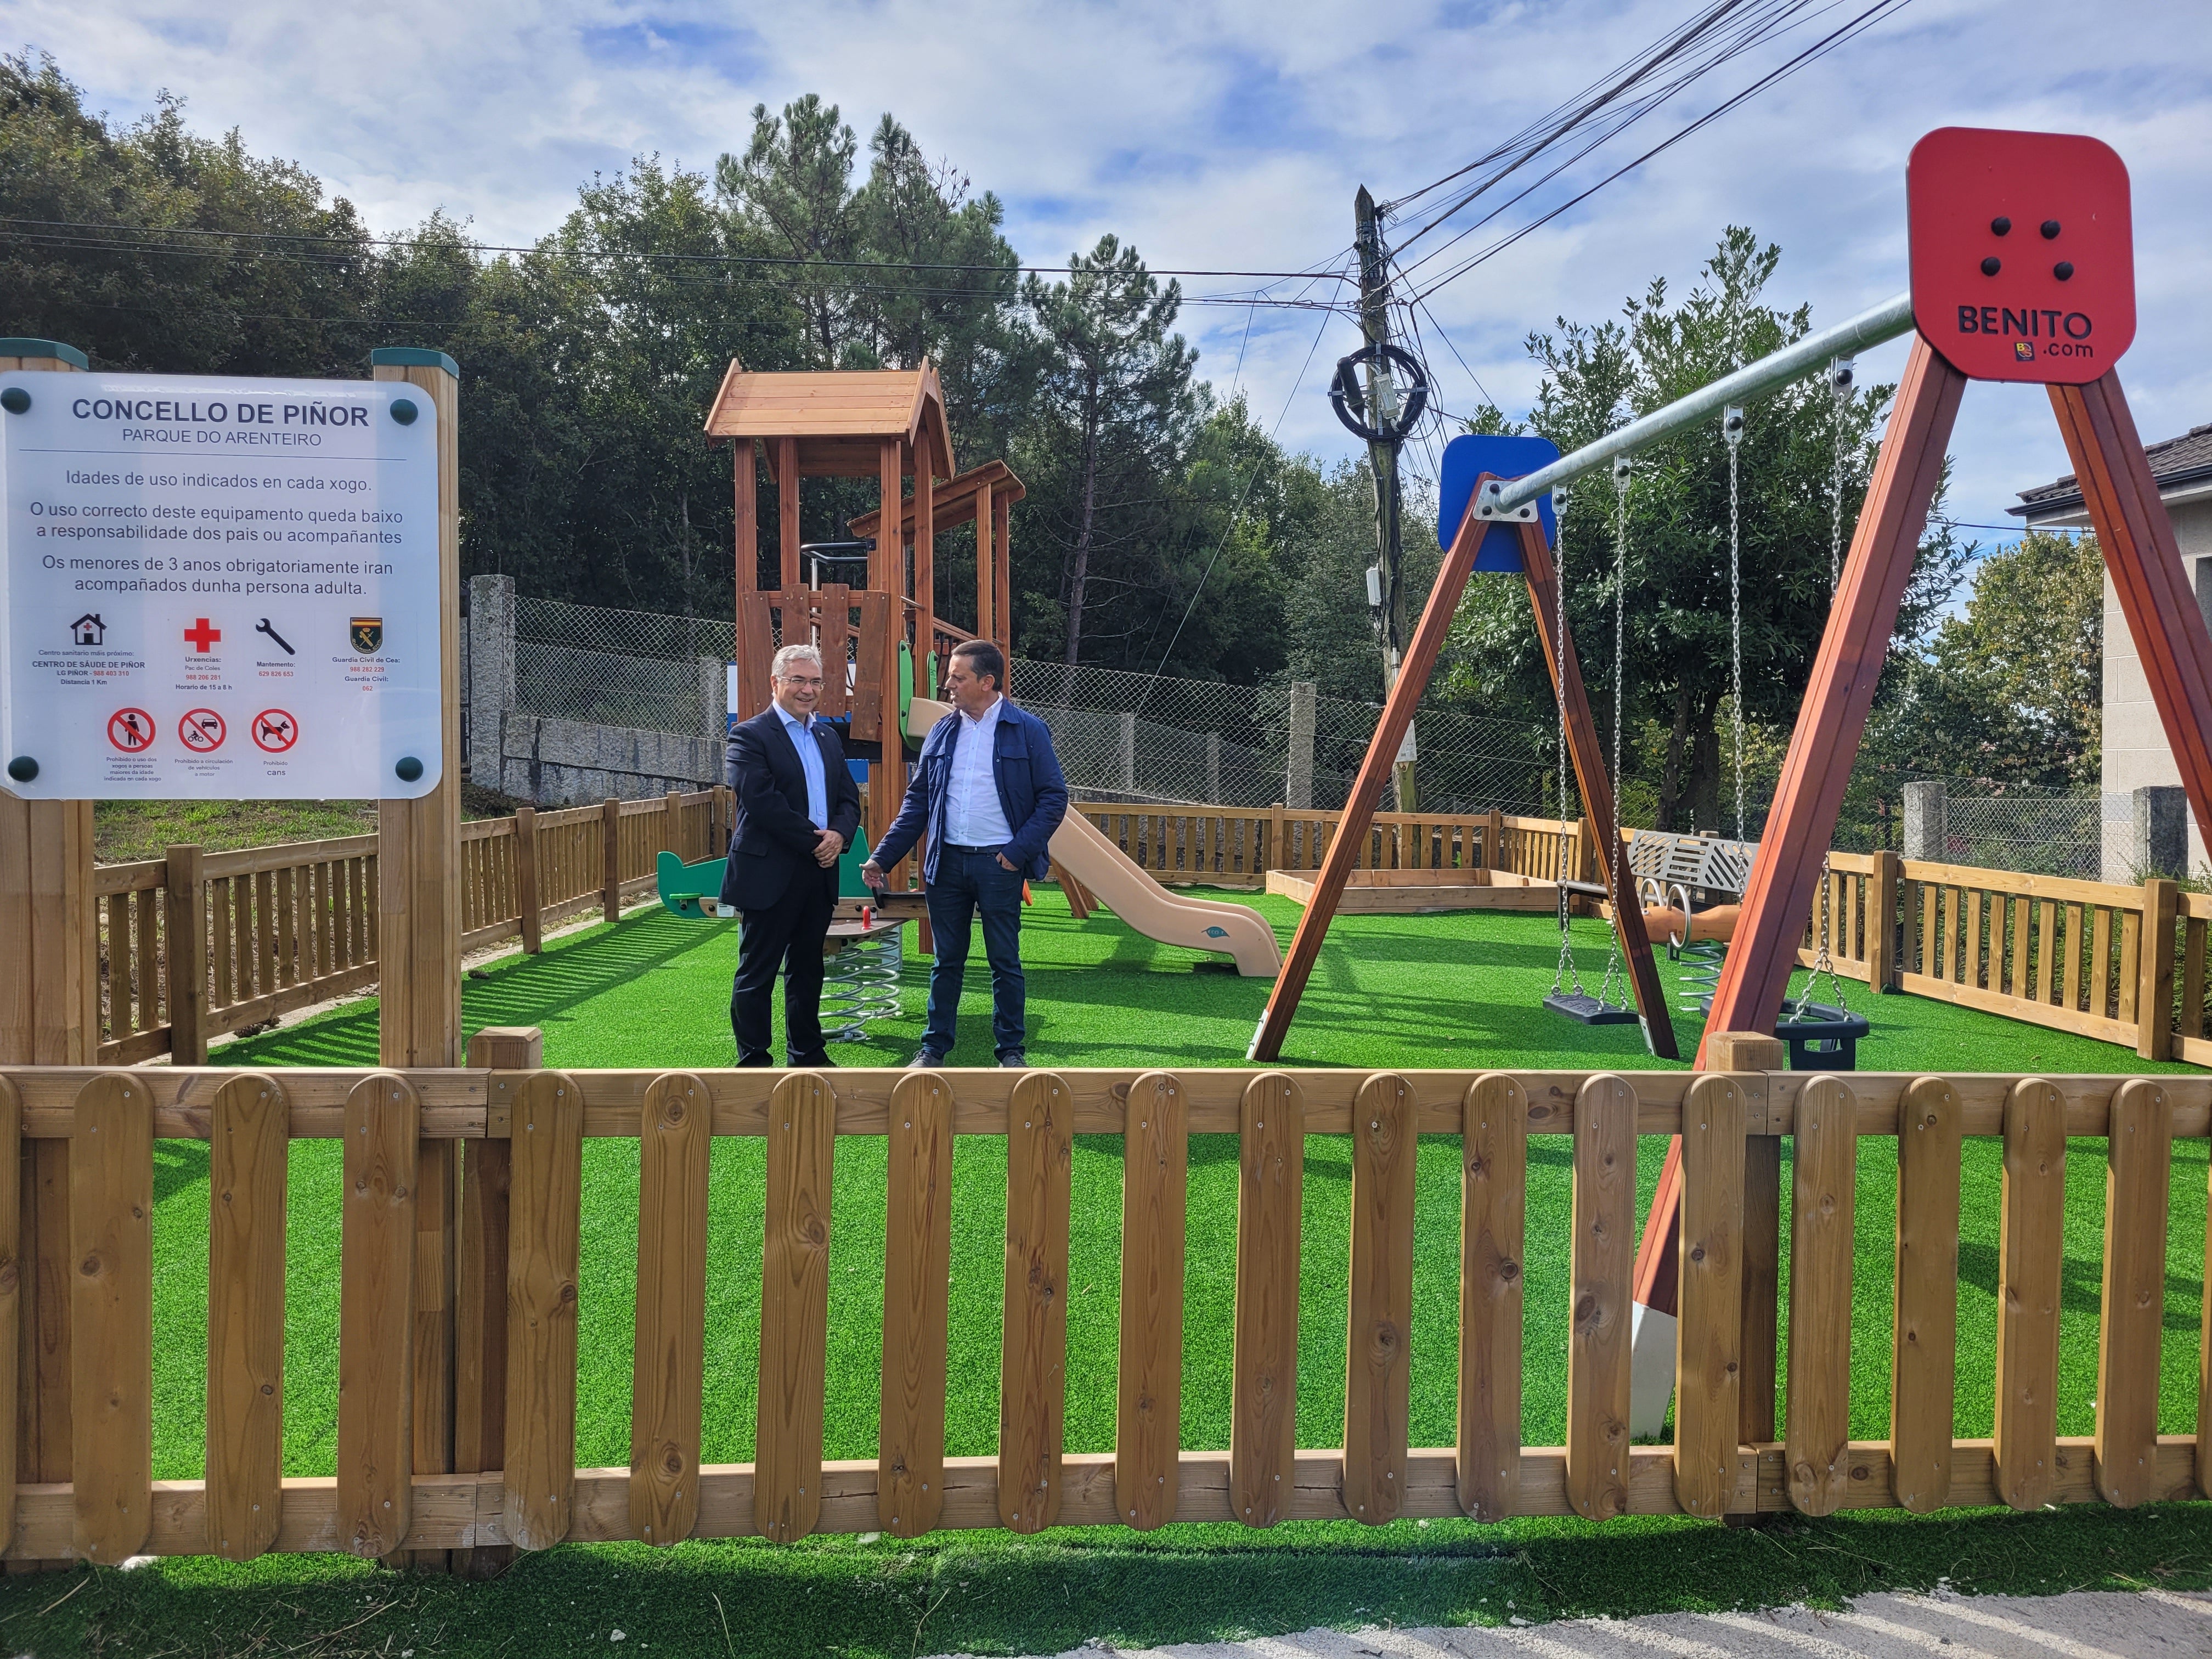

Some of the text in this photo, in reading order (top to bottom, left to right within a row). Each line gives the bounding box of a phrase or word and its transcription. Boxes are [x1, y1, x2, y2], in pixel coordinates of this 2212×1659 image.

[1958, 306, 2092, 340] BENITO
[2043, 343, 2093, 358] .com
[73, 399, 369, 426] CONCELLO DE PIÑOR
[123, 429, 321, 445] PARQUE DO ARENTEIRO
[67, 470, 371, 493] Idades de uso indicados en cada xogo.
[31, 502, 402, 524] O uso correcto deste equipamento queda baixo
[37, 525, 402, 545] a responsabilidade dos pais ou acompañantes
[43, 555, 392, 575] Os menores de 3 anos obrigatoriamente iran
[75, 578, 366, 596] acompañados dunha persona adulta.
